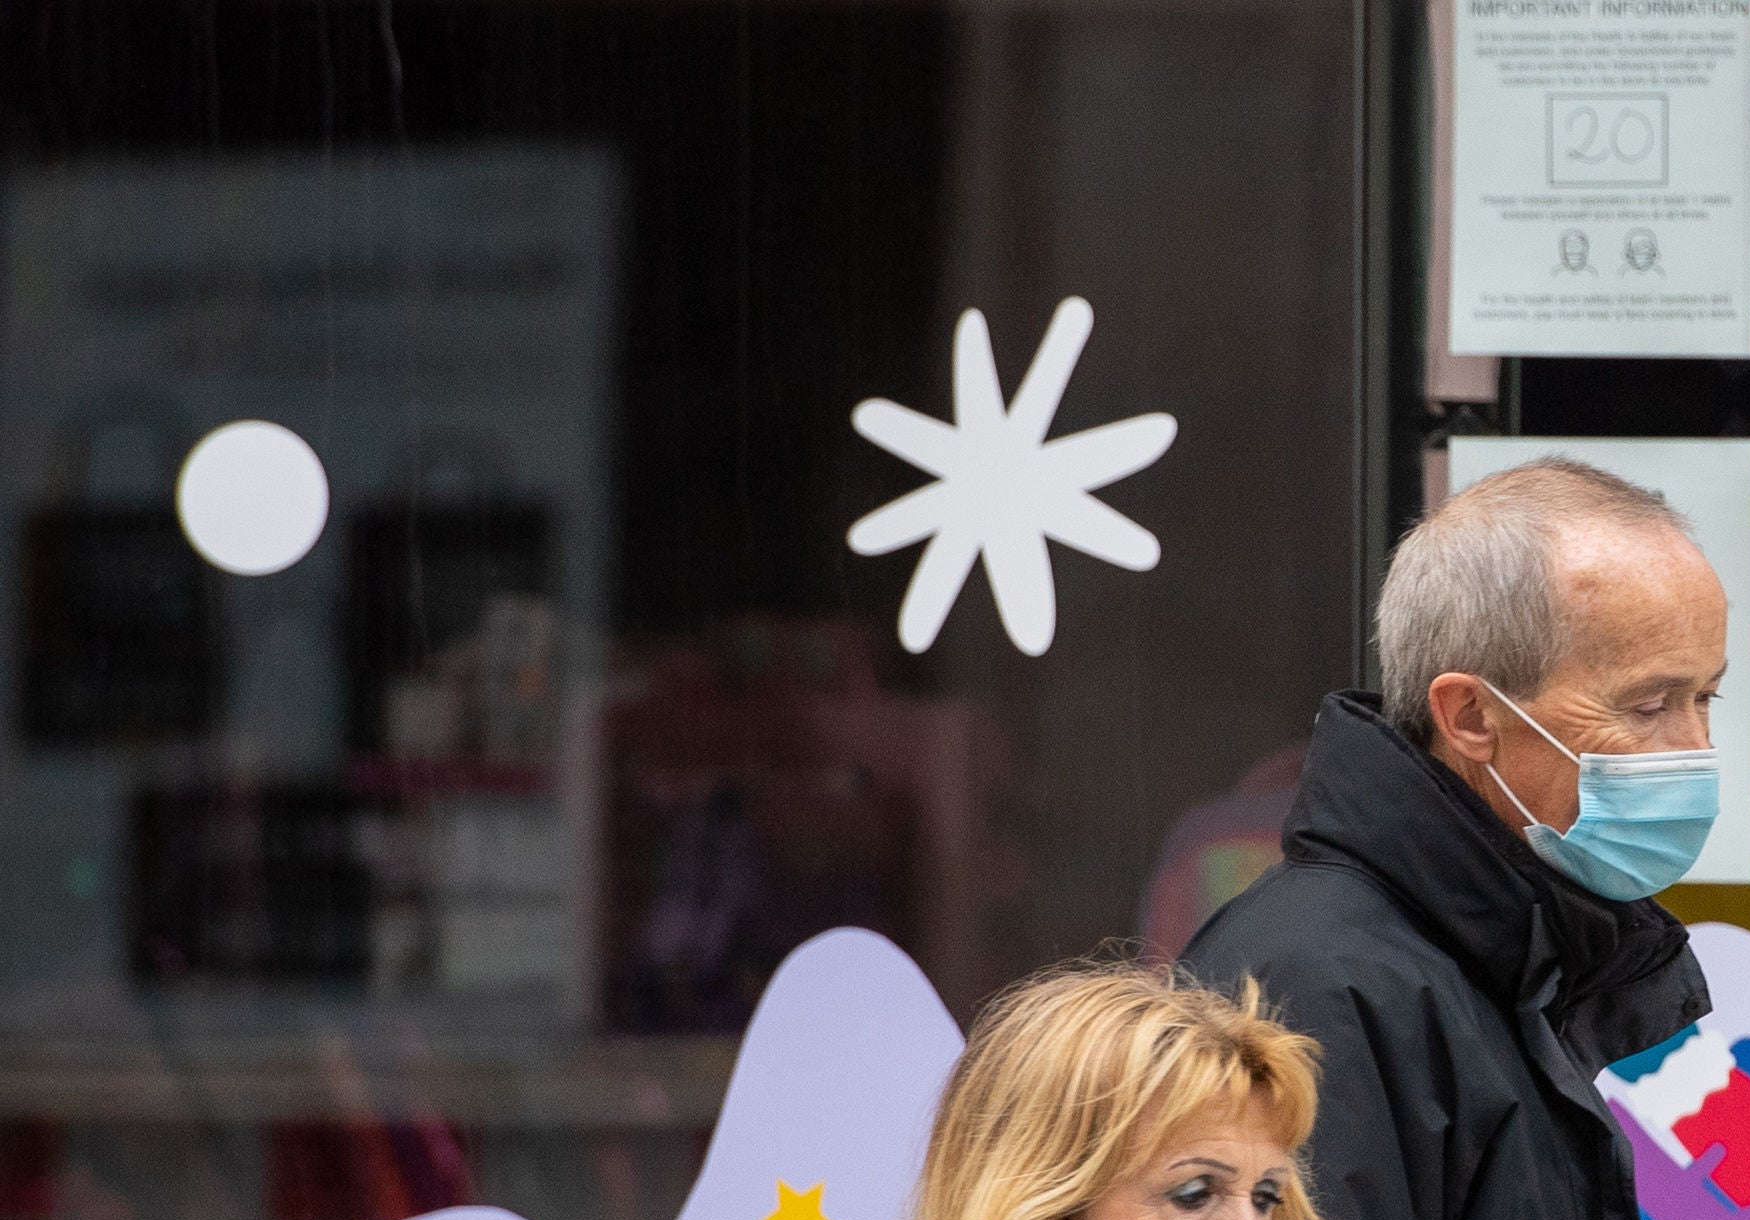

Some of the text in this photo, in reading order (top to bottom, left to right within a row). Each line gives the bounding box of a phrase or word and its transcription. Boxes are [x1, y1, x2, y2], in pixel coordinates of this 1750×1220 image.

[1469, 0, 1750, 17] IMPORTANT INFORMATION
[1564, 105, 1655, 165] 20
